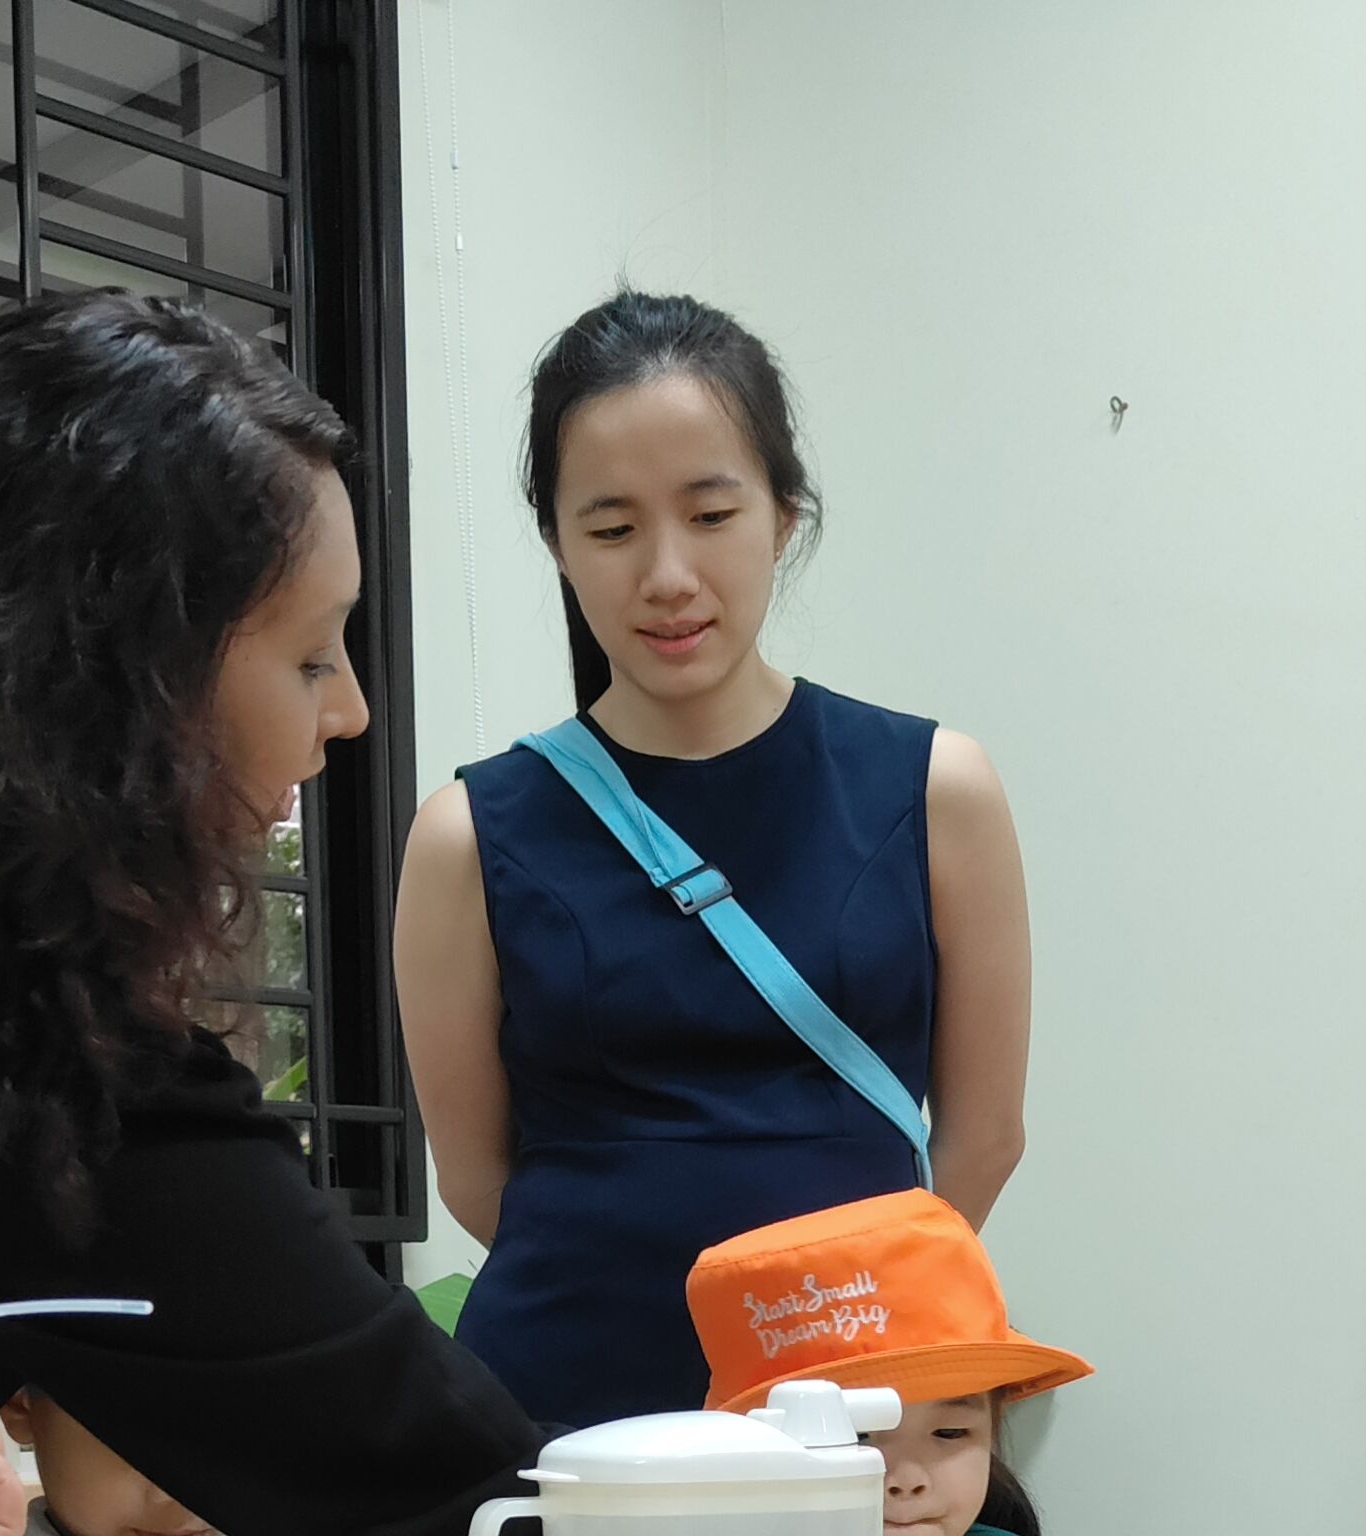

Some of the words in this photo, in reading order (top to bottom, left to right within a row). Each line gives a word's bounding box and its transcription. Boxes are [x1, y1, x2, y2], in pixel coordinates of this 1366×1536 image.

[743, 1292, 804, 1329] Start
[801, 1271, 878, 1312] Small
[757, 1320, 832, 1359] Dream
[829, 1305, 892, 1341] Big
